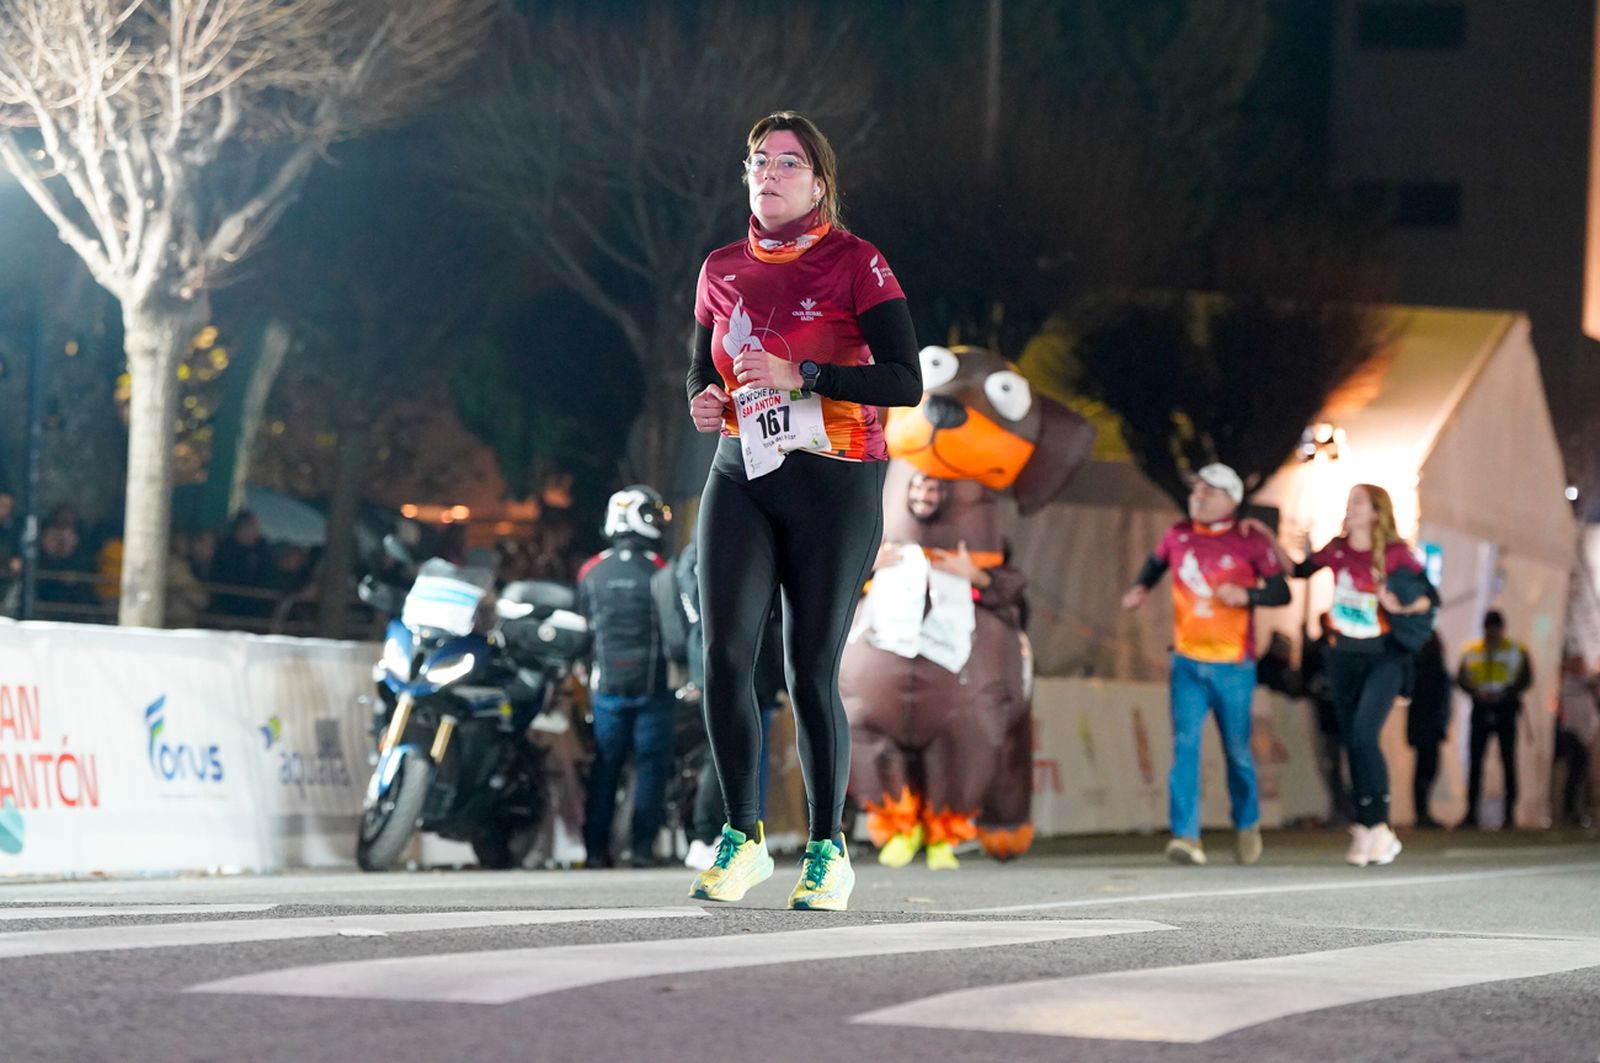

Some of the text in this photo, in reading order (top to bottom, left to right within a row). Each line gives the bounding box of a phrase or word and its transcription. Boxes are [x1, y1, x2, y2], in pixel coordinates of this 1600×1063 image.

[742, 405, 753, 418] SAN
[756, 405, 790, 439] 167
[0, 735, 99, 809] ANTÓN
